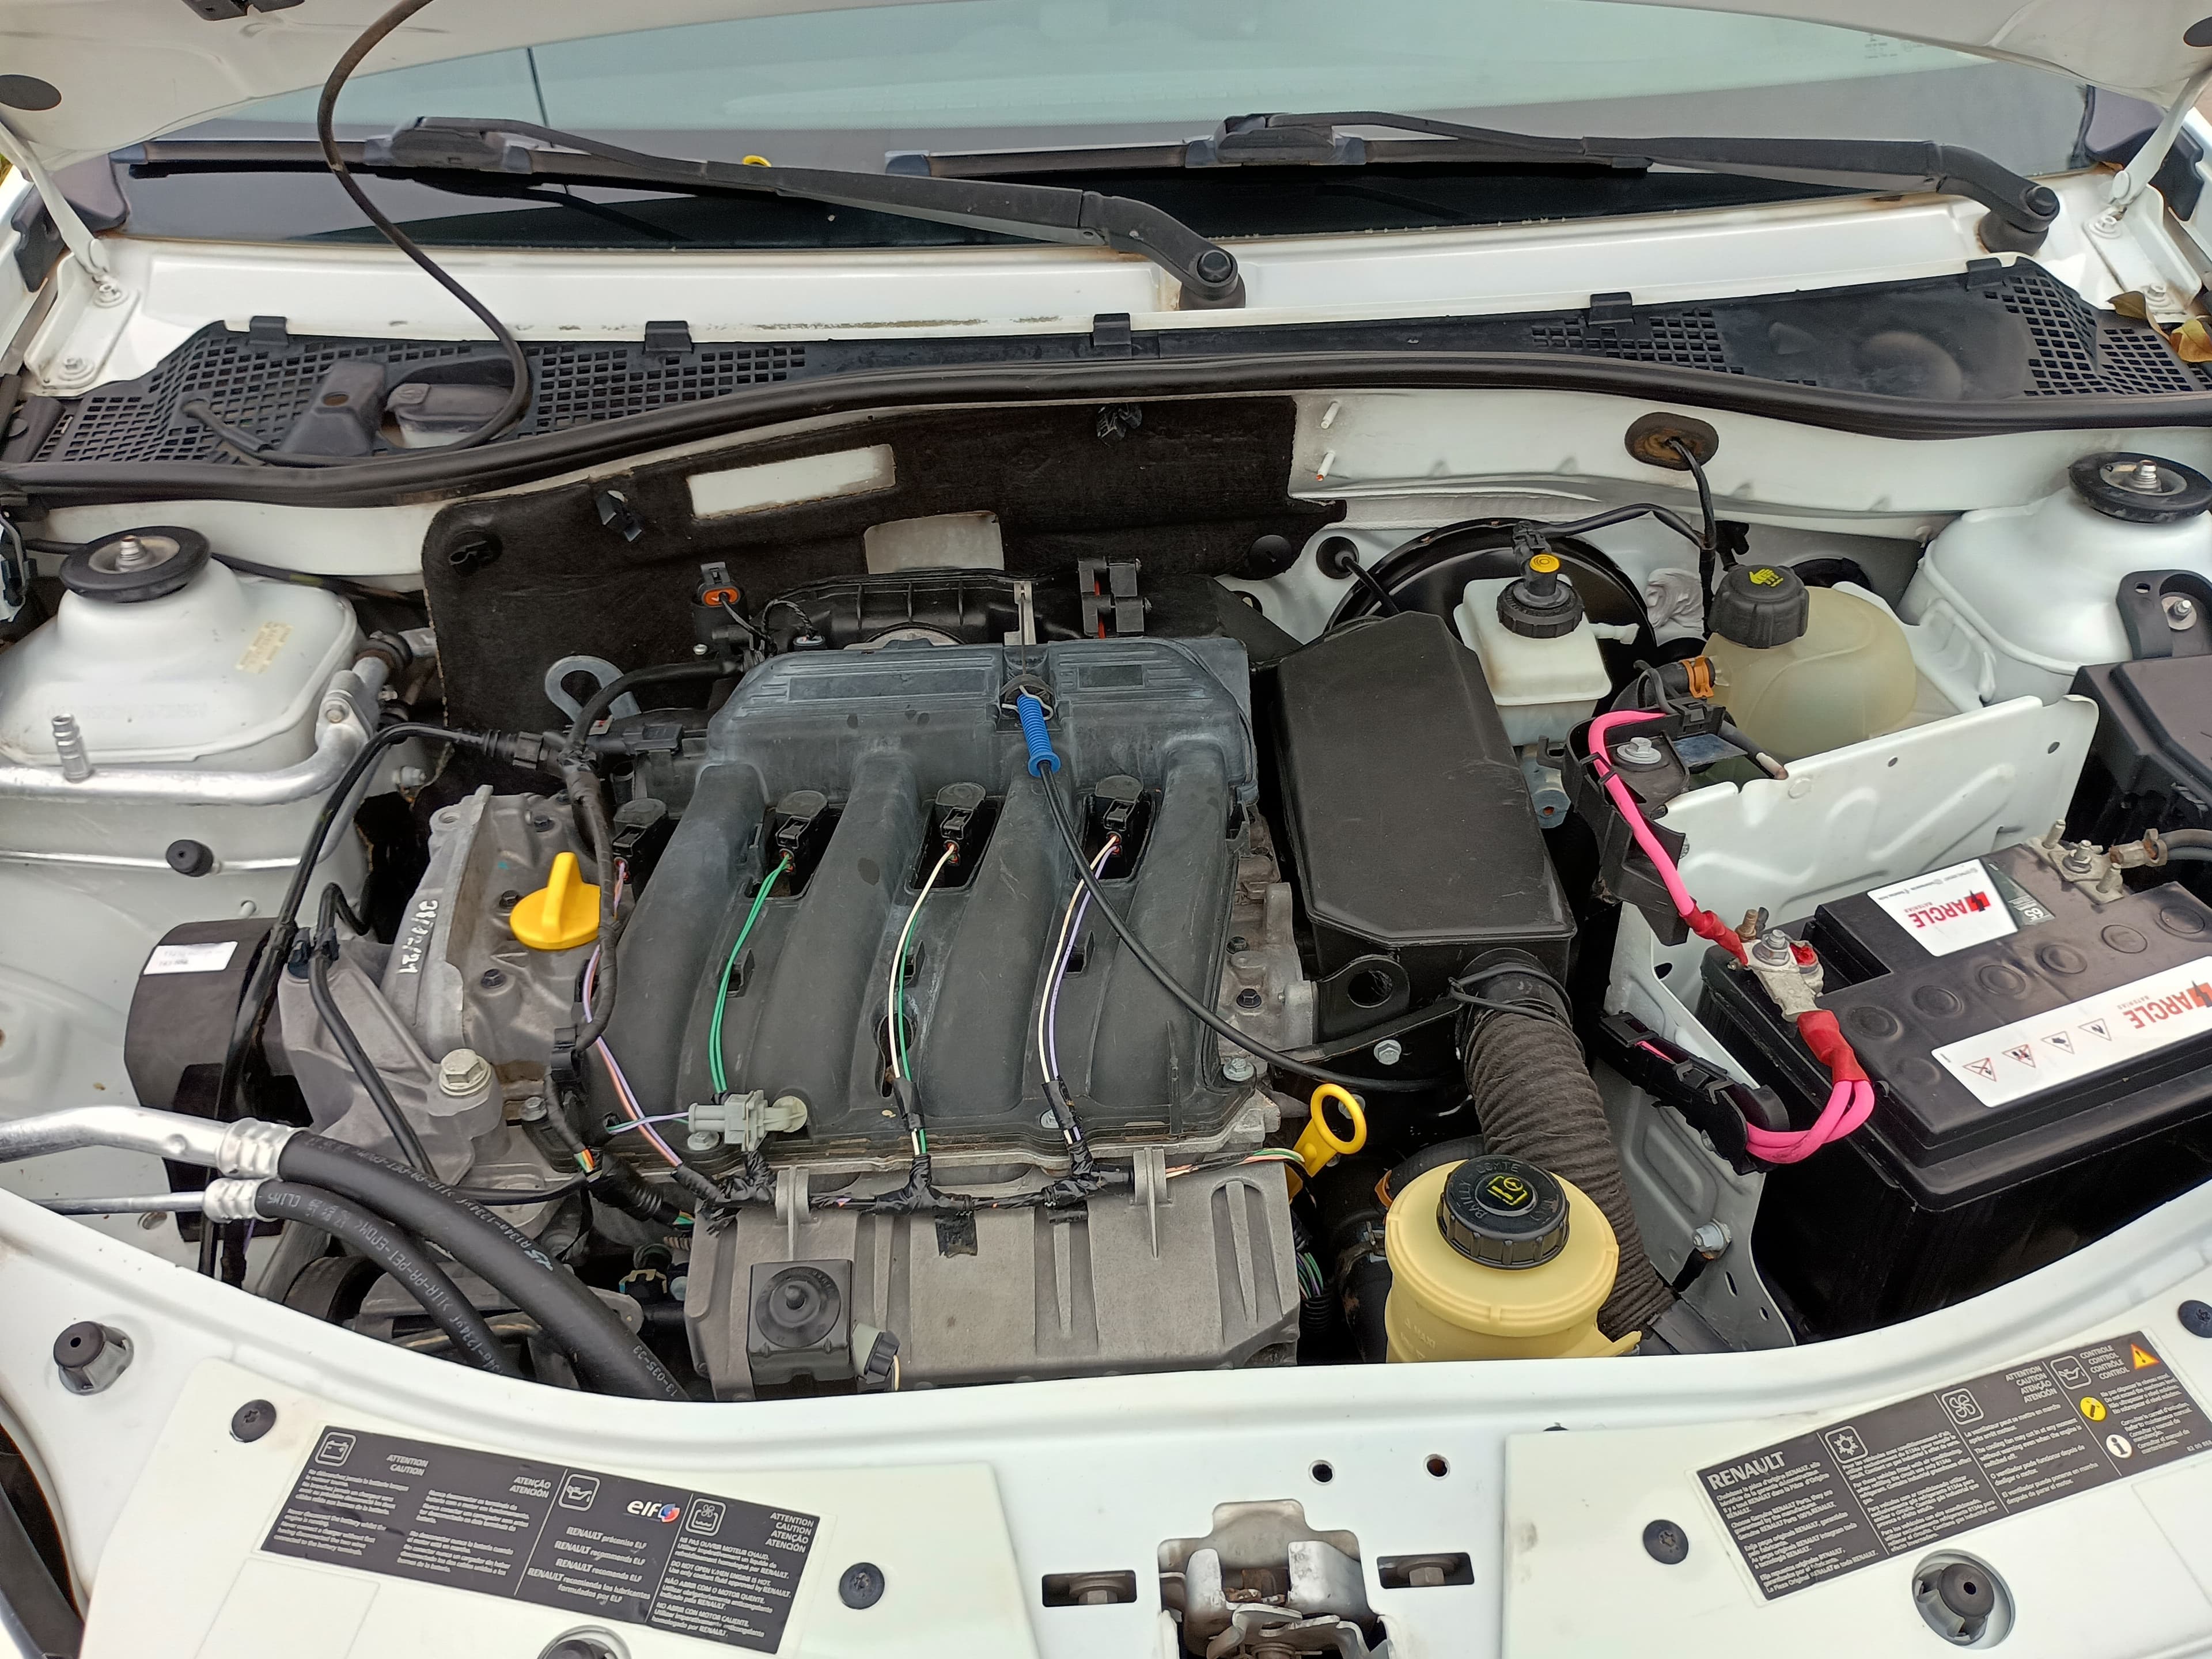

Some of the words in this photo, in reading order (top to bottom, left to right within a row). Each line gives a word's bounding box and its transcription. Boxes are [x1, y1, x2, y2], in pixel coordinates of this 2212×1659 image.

[2023, 907, 2044, 919] 65
[2122, 991, 2194, 1029] ARCLE
[2080, 1345, 2114, 1359] CONTROLE
[2088, 1352, 2119, 1365] CONTROL
[632, 1344, 679, 1397] 13-035-33
[2090, 1359, 2124, 1373] CONTRÔLE
[2099, 1366, 2130, 1380] CONTROL
[2005, 1366, 2042, 1381] ATTENTION
[2016, 1373, 2047, 1386] CAUTION
[2021, 1380, 2052, 1395] ATENÇÃO
[2024, 1388, 2058, 1403] ATENCIÓN
[387, 1455, 429, 1467] ATTENTION
[390, 1464, 425, 1476] CAUTION
[1708, 1452, 1784, 1489] RENAULT
[514, 1476, 551, 1489] ATENÇÃO
[509, 1485, 549, 1498] ATENCIÓN
[627, 1501, 661, 1517] elf
[770, 1513, 814, 1527] ATTENTION
[775, 1522, 812, 1536] CAUTION
[566, 1527, 603, 1540] RENAULT
[634, 1541, 647, 1550] ELF
[771, 1530, 809, 1544] ATENÇÃO
[765, 1538, 806, 1553] ATENCIÓN
[554, 1540, 591, 1554] RENAULT
[632, 1557, 646, 1566] ELF
[555, 1558, 593, 1572] RENAULT
[629, 1574, 642, 1582] ELF
[527, 1567, 564, 1581] RENAULT
[602, 1583, 613, 1592] los
[613, 1586, 651, 1600] lubricantes
[558, 1584, 596, 1597] formulados
[596, 1593, 610, 1602] por
[609, 1594, 623, 1603] ELF
